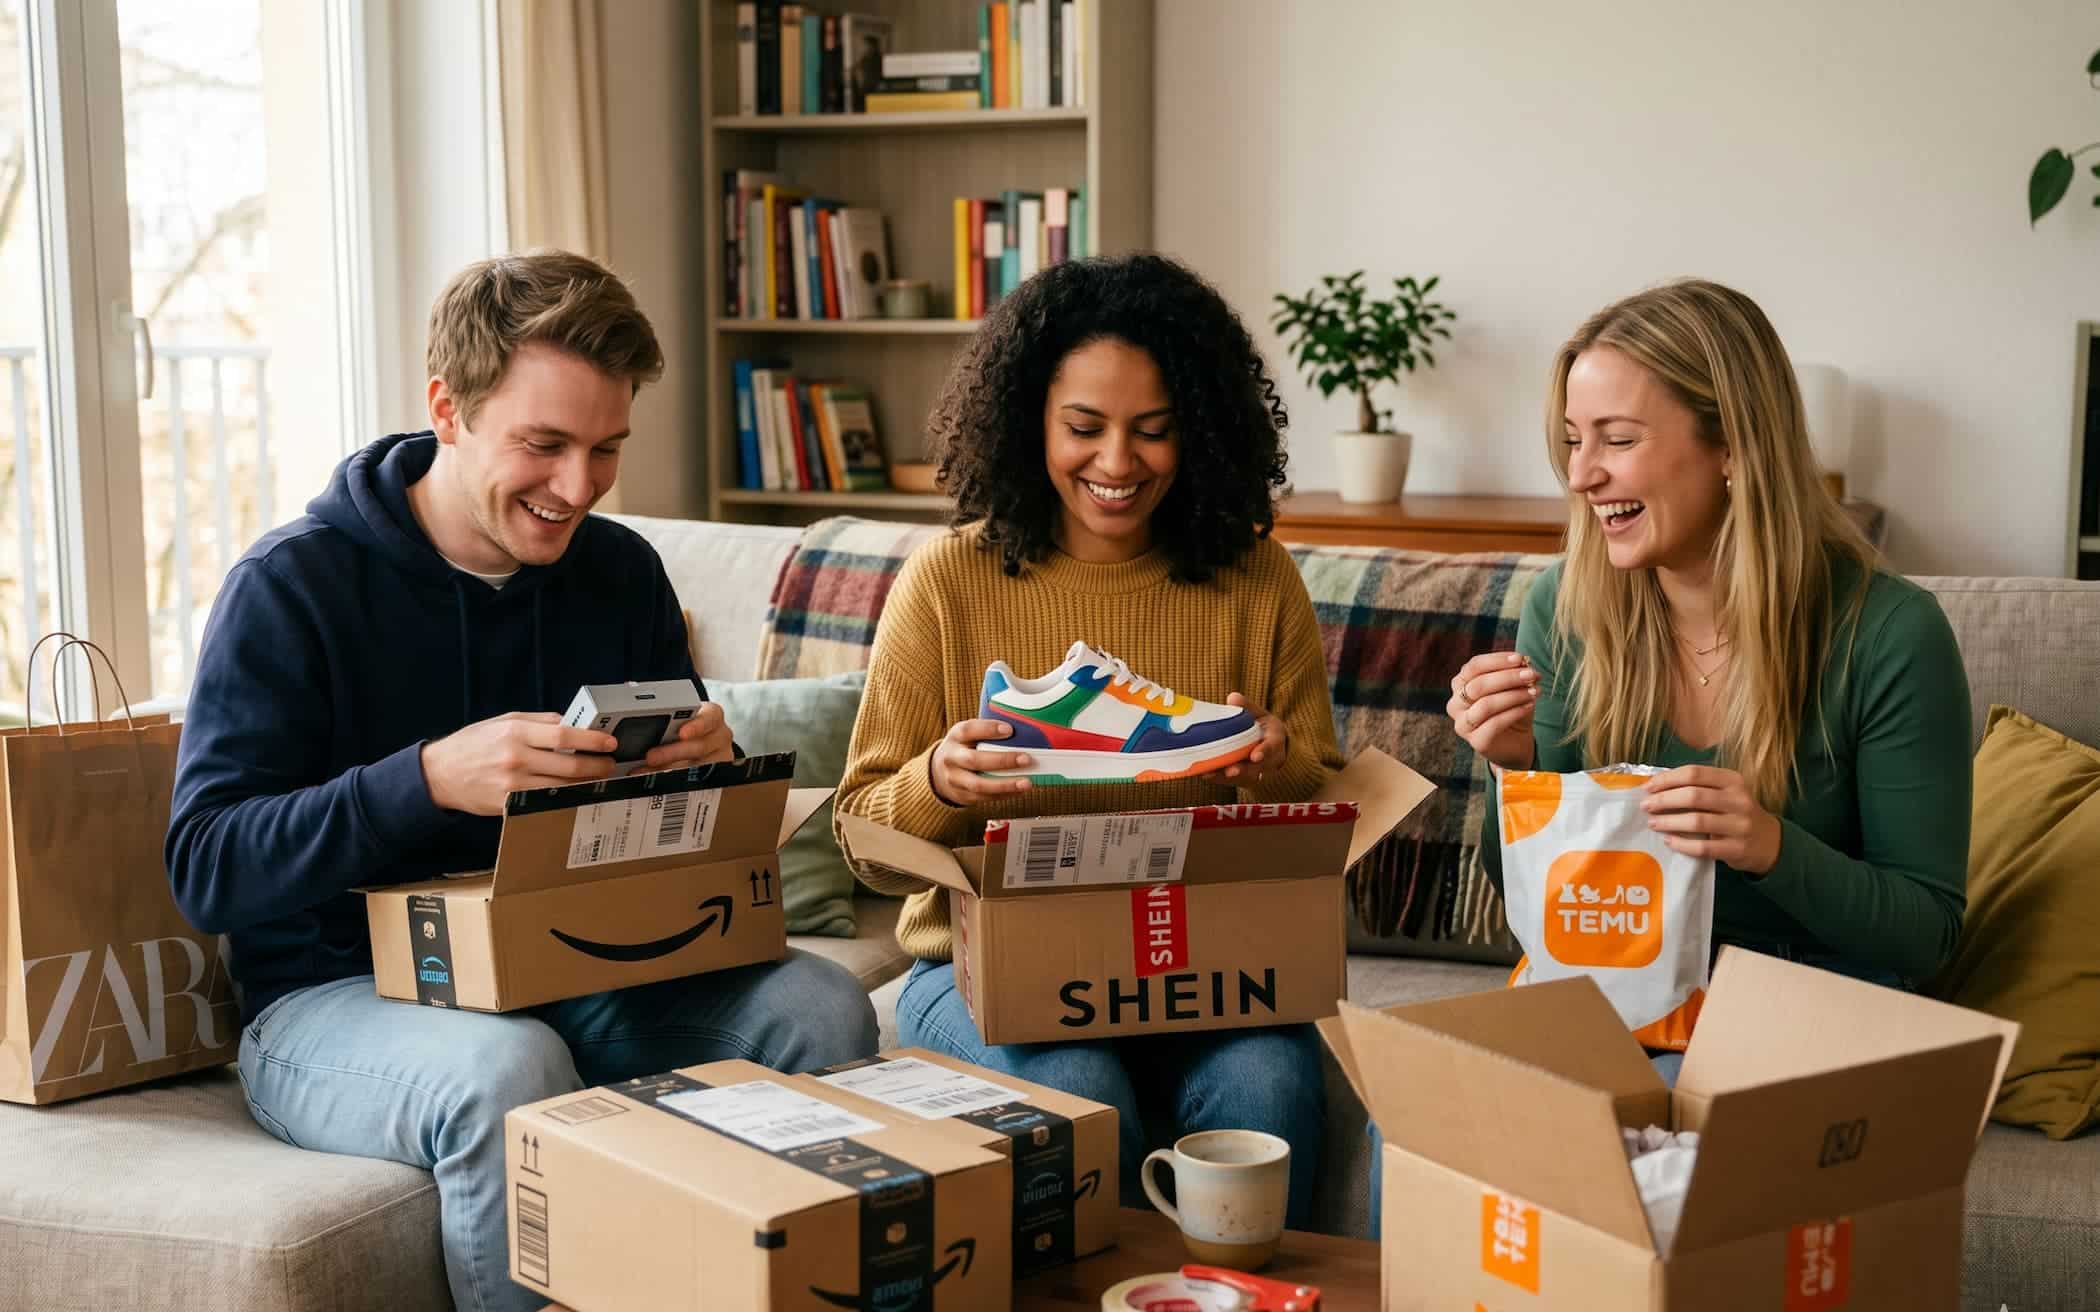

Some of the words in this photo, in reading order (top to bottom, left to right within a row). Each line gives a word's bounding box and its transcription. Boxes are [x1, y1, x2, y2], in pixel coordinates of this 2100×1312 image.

[1217, 803, 1338, 821] SHEIN
[1148, 883, 1173, 966] SHEIN
[1557, 909, 1649, 934] TEMU
[23, 932, 243, 1086] ZARA
[1059, 968, 1277, 1028] SHEIN
